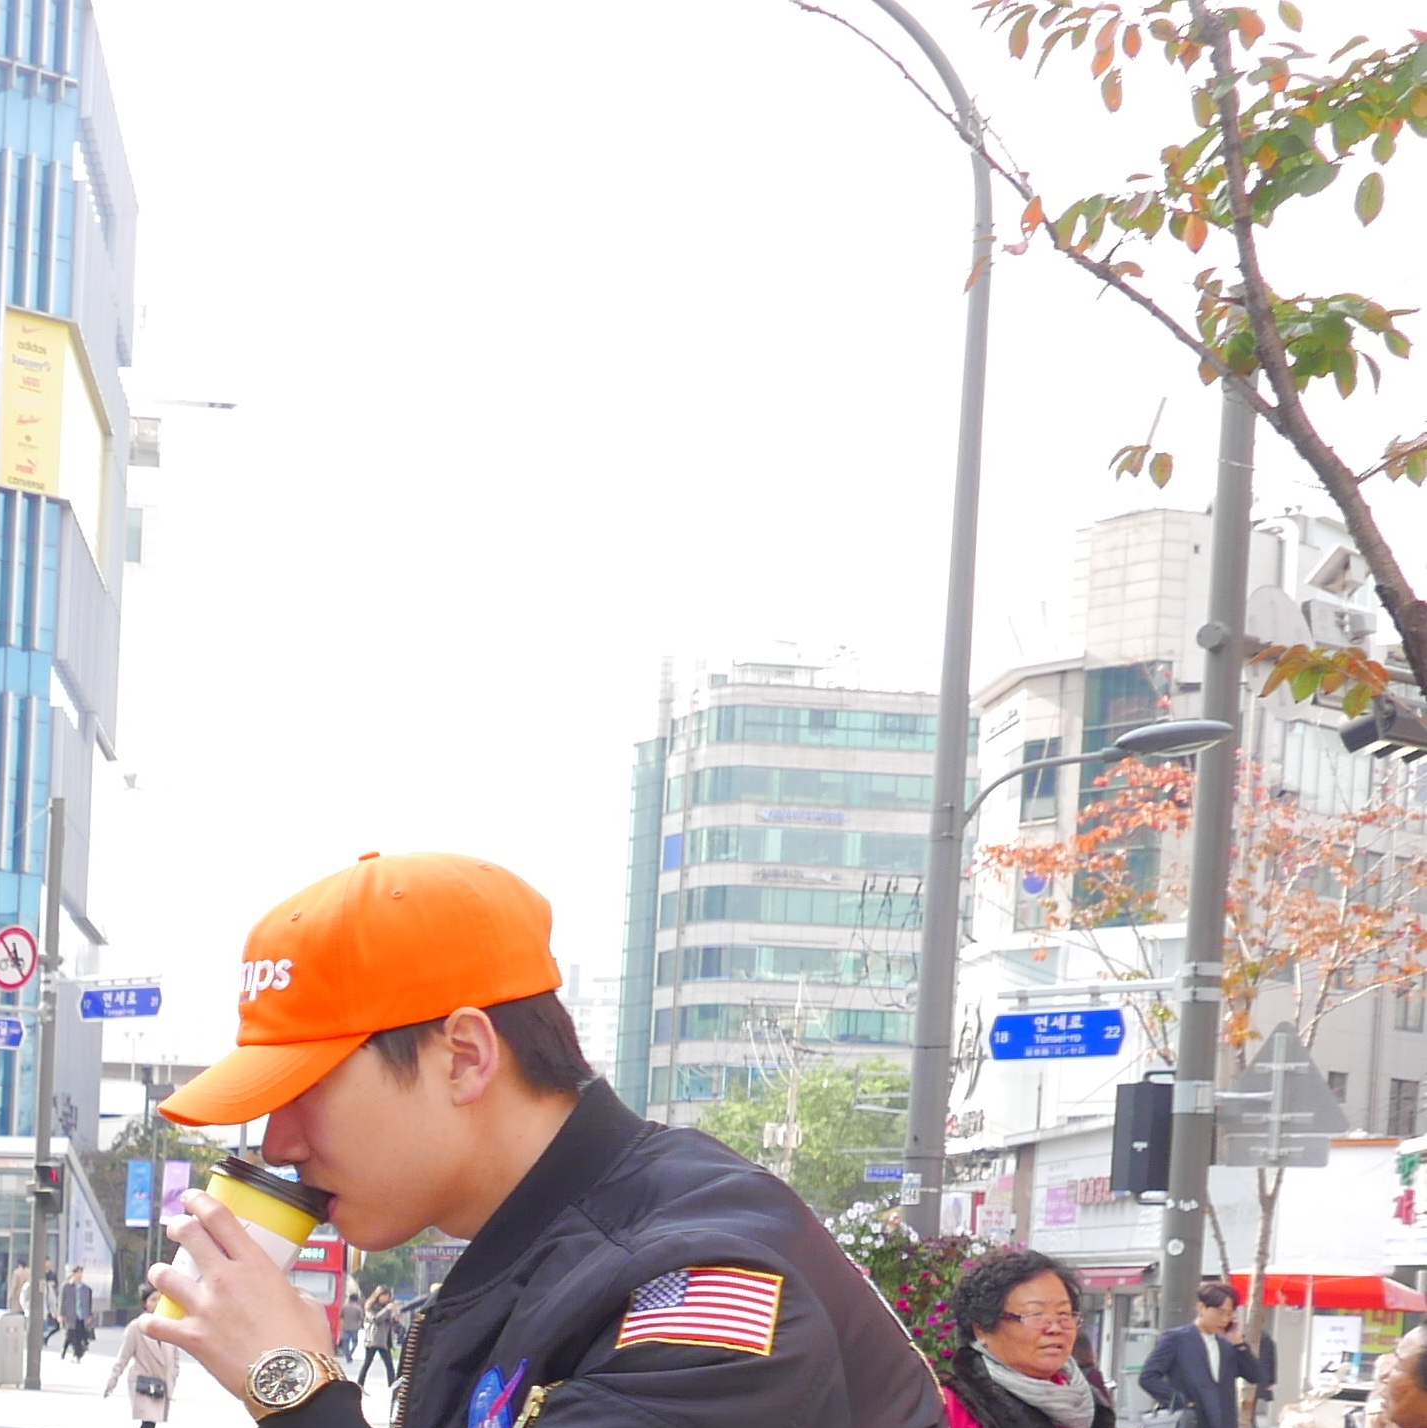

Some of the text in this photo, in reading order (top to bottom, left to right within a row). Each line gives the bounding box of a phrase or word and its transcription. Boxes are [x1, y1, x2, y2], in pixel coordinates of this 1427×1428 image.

[102, 990, 137, 1008] 연세로
[1033, 1015, 1085, 1033] 연세로
[993, 1026, 1121, 1044] 18 Yonsei-ro 22
